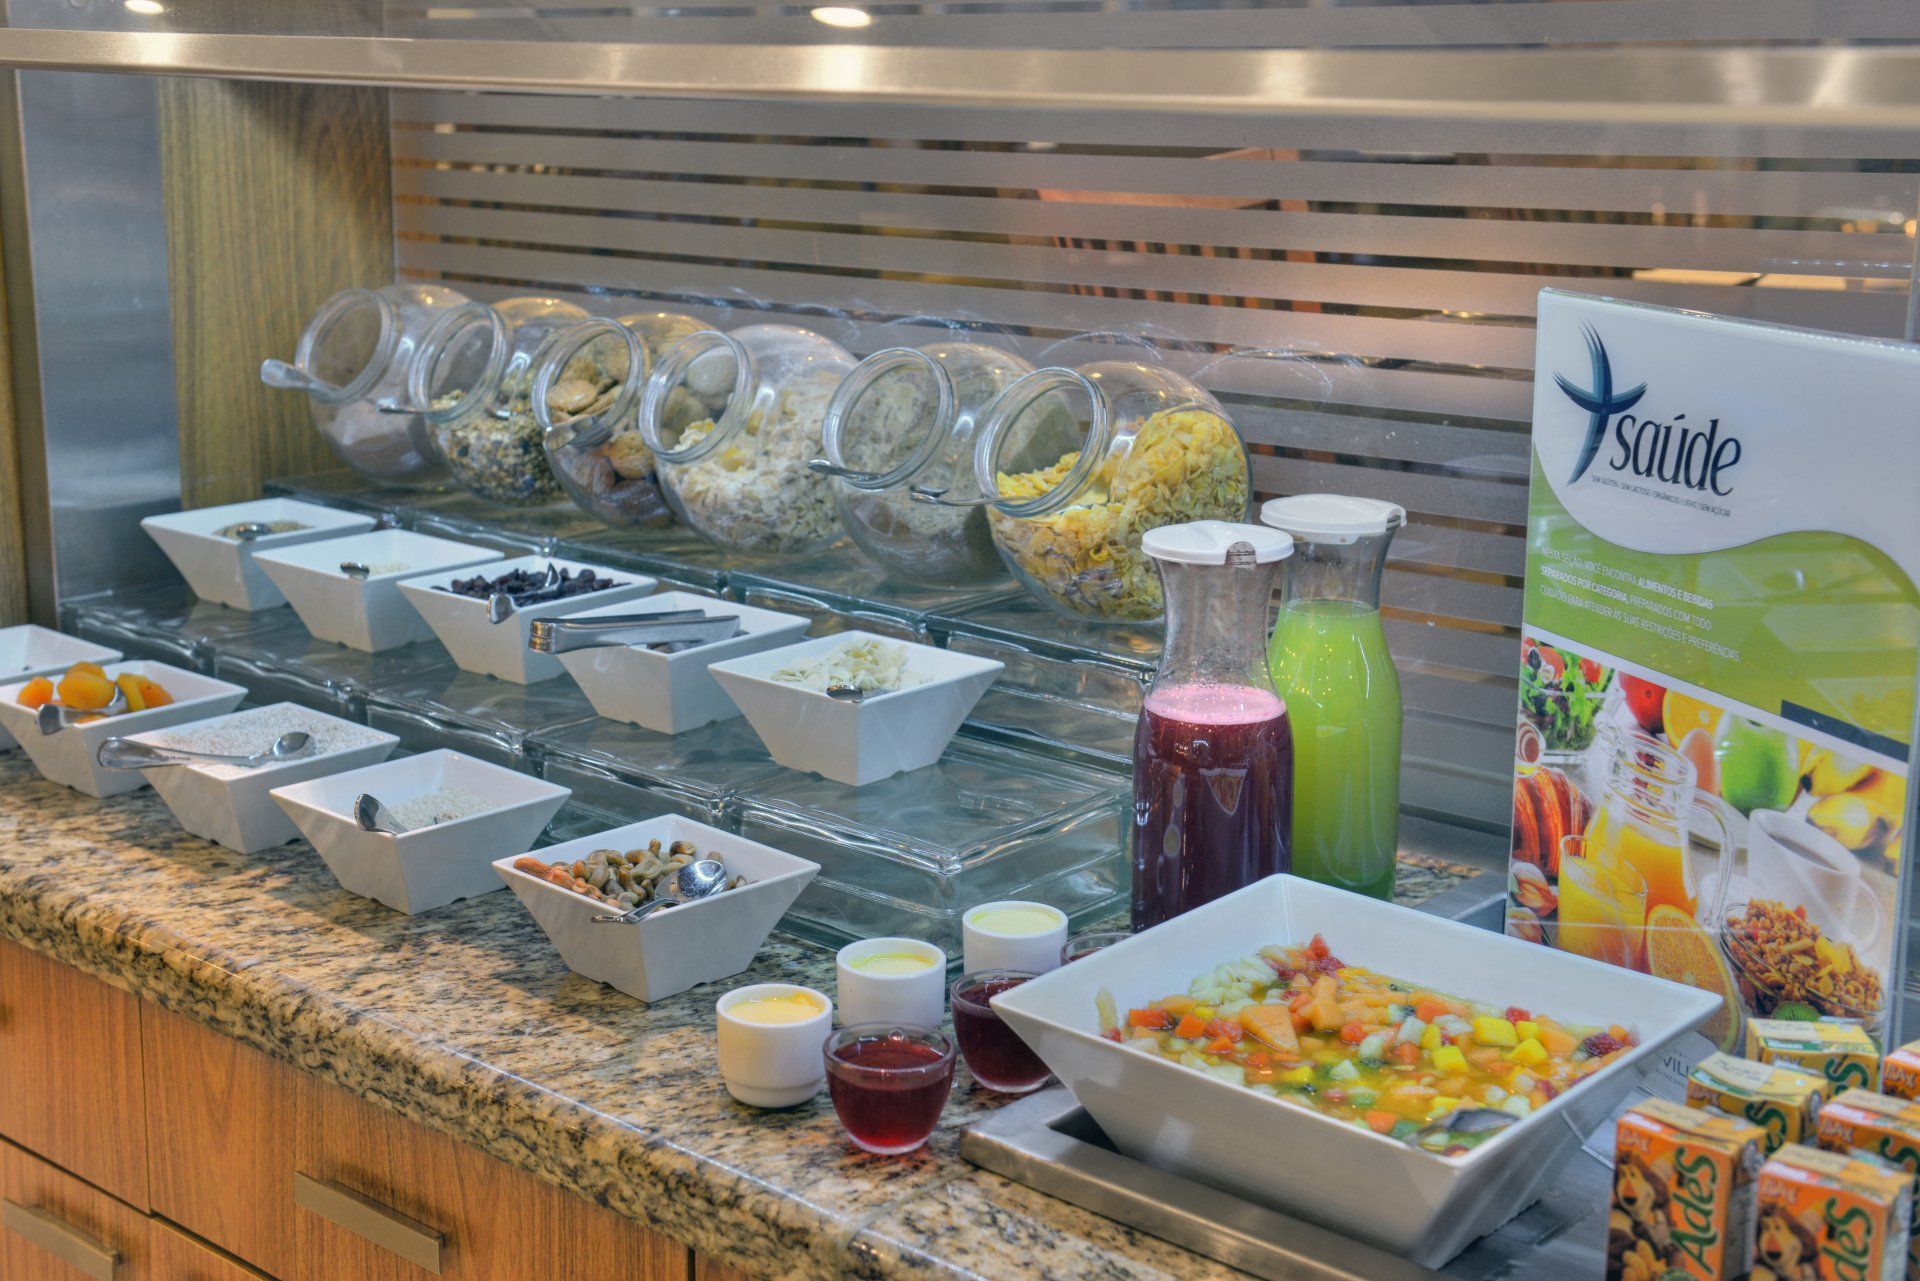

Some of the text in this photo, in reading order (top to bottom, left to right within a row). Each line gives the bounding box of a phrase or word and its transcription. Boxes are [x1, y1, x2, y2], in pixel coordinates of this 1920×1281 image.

[1609, 414, 1742, 497] saúde
[1540, 584, 1567, 602] CUIDADO
[1567, 594, 1584, 608] PARA
[1584, 600, 1613, 617] ATENDER
[1622, 612, 1641, 627] SUAS
[1541, 565, 1712, 631] SEPARADOS POR CATEGORIA, PREPARADOS COM TODO
[1602, 565, 1637, 585] ENCONTRA
[1638, 577, 1677, 598] ALIMENTOS
[1677, 589, 1683, 600] E
[1683, 591, 1714, 610] BEBIDAS
